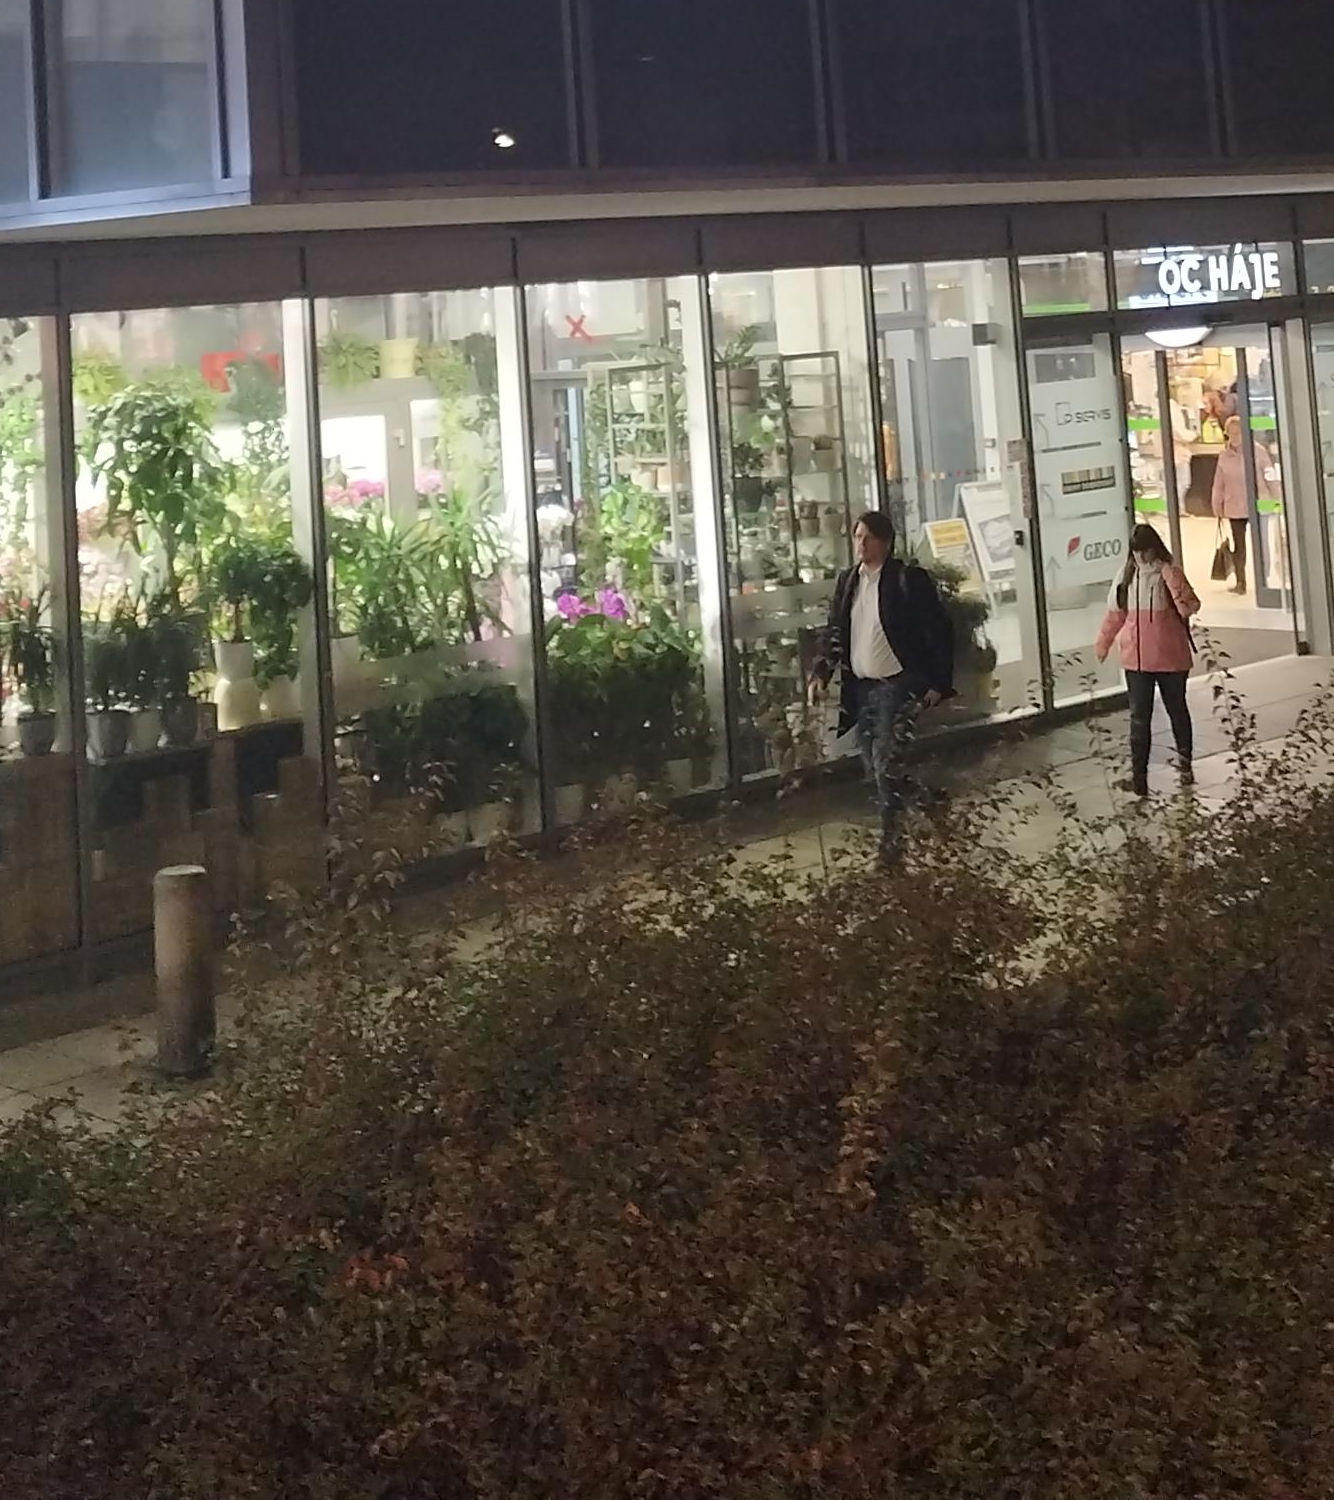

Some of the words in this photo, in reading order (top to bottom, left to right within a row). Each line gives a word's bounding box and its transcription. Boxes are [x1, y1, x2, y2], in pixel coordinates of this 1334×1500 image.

[1158, 257, 1203, 295] OC
[1208, 243, 1281, 300] HÁJE
[1083, 538, 1122, 561] GECO
